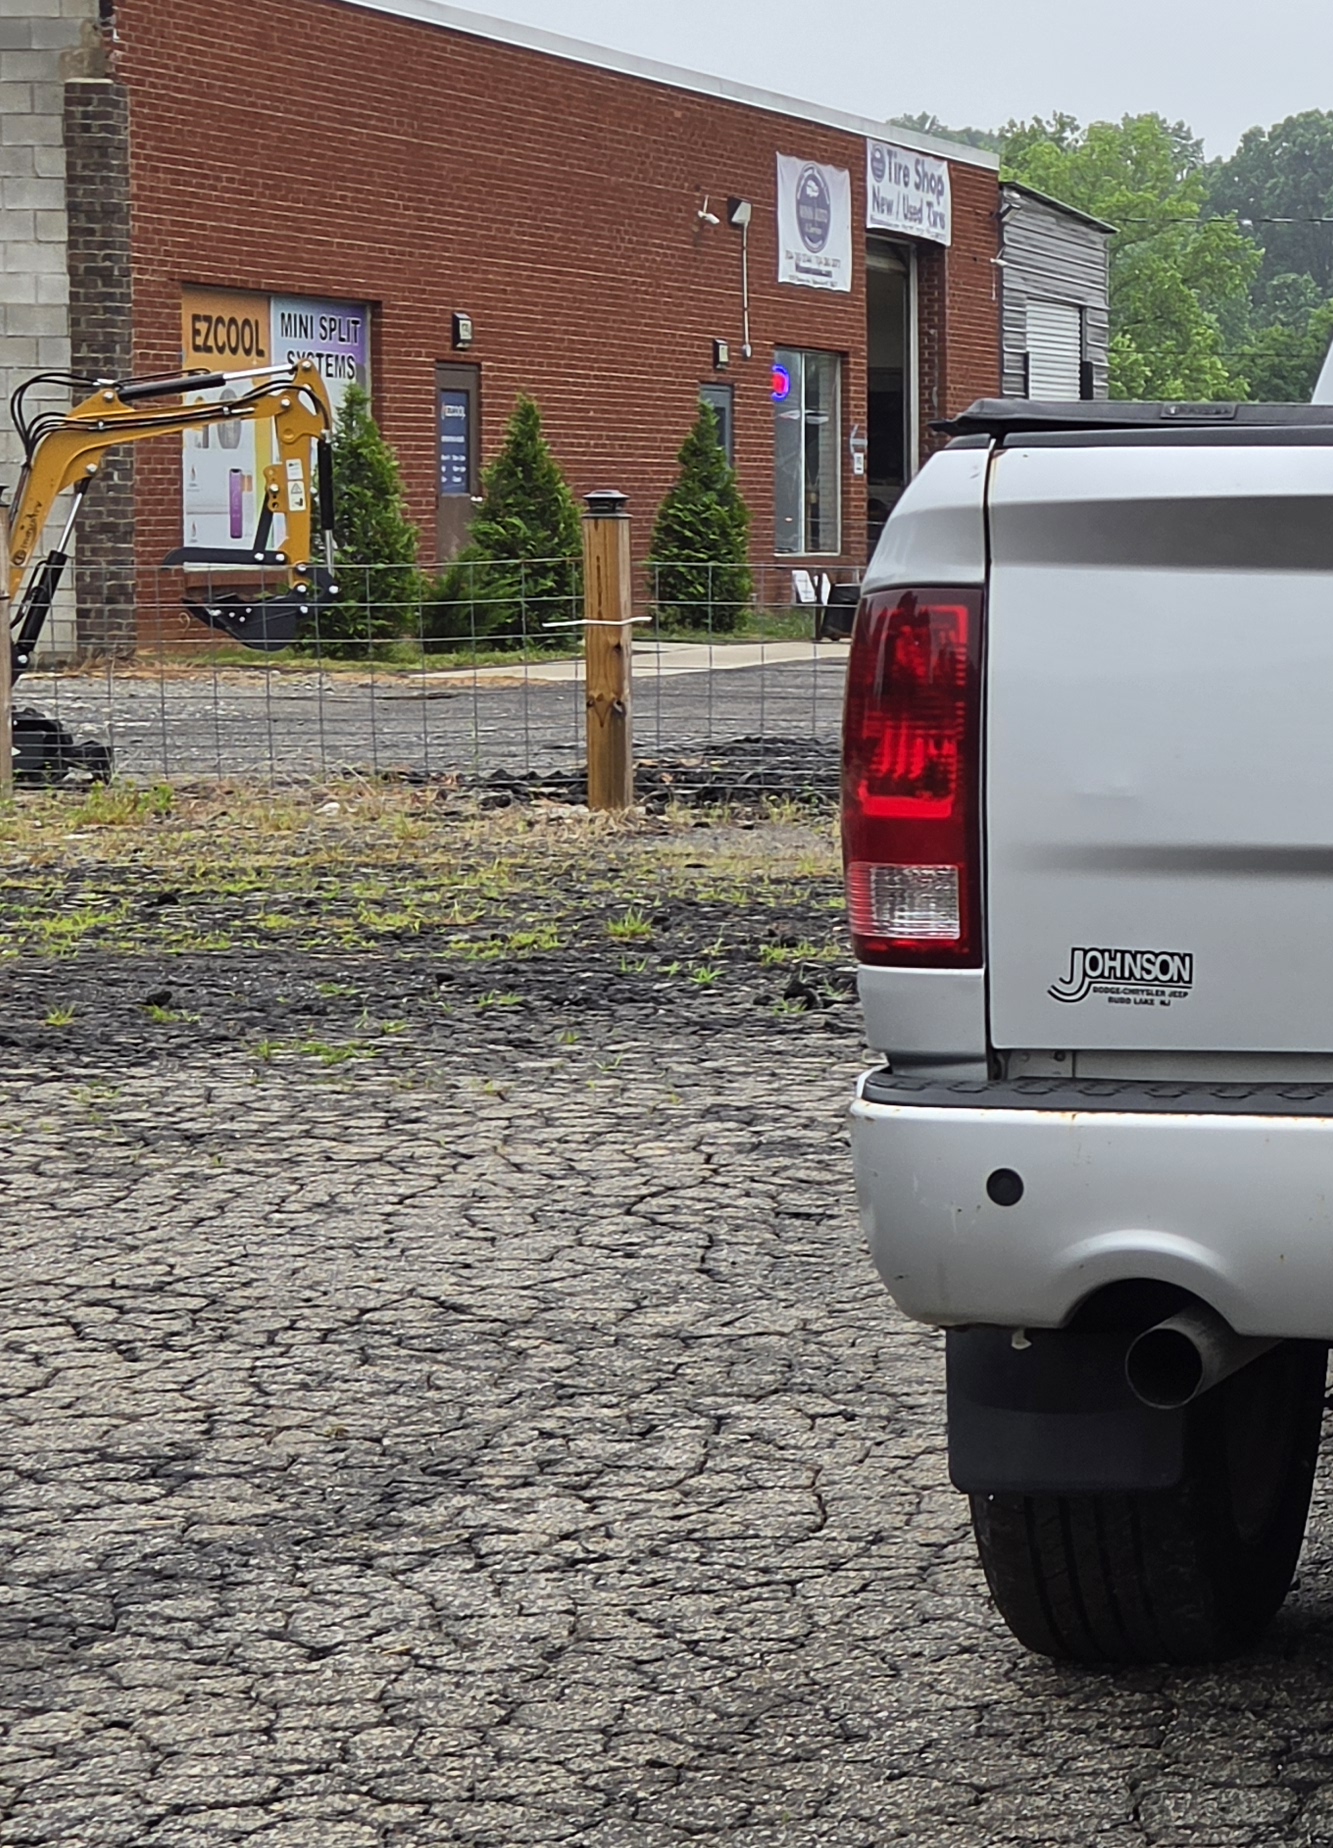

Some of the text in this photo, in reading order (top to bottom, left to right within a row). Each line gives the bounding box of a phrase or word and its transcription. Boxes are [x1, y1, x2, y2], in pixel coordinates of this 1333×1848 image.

[886, 148, 945, 206] Tire Shop
[872, 184, 894, 216] New
[902, 193, 923, 224] Used
[192, 313, 266, 358] EZCOOL
[280, 312, 361, 344] MINI SPLIT
[287, 350, 356, 380] STEMS
[1048, 946, 1193, 1003] JOHNSON
